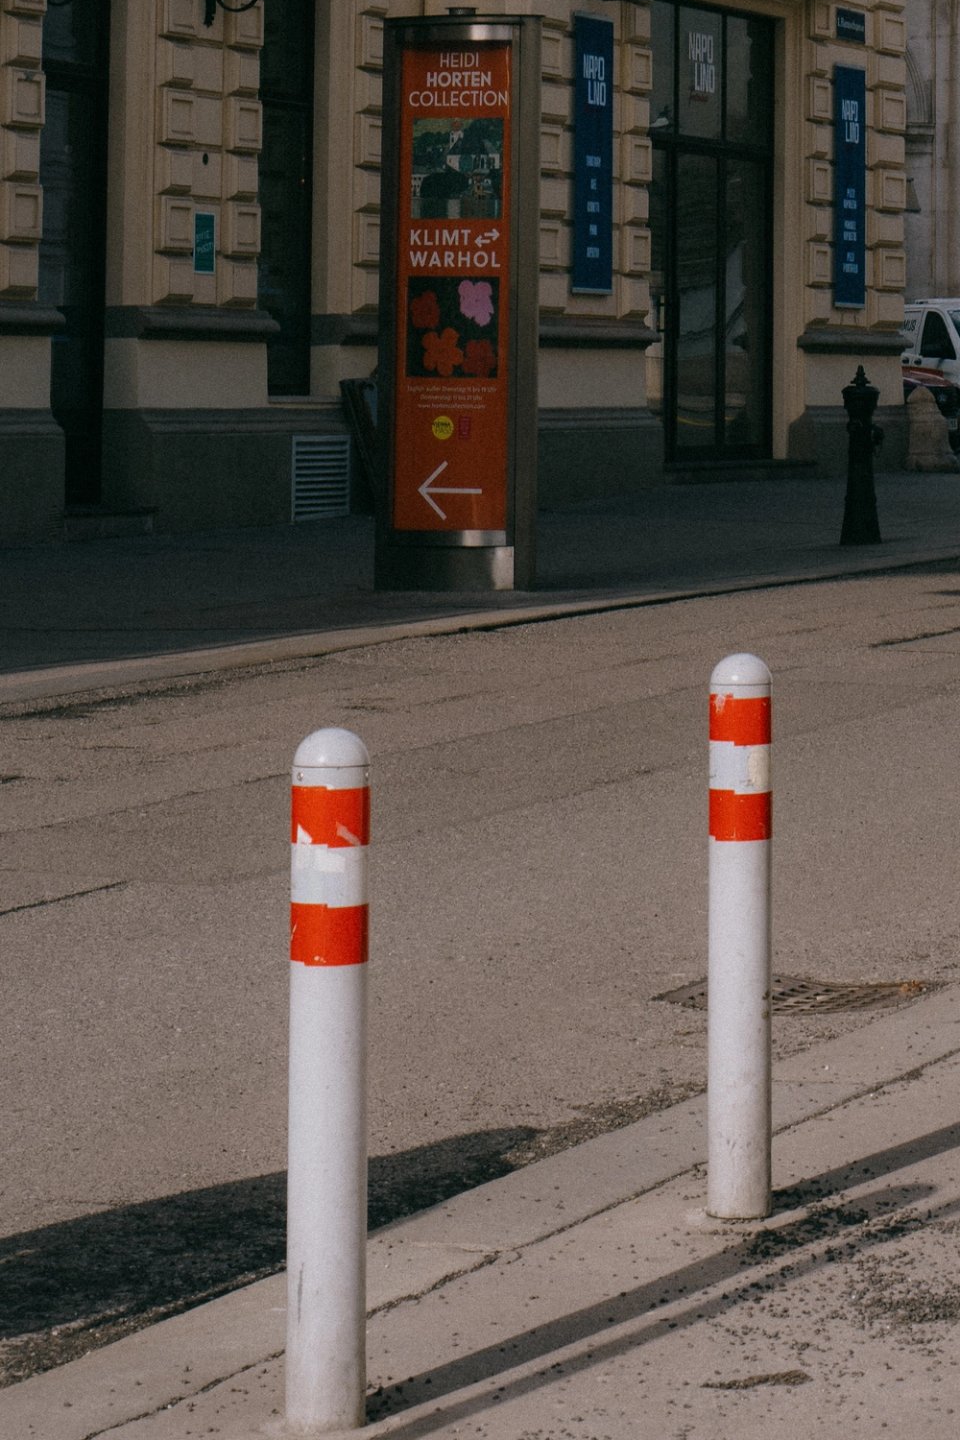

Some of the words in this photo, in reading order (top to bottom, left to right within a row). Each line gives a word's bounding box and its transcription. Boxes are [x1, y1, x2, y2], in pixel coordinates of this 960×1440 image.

[688, 32, 714, 63] NAPO
[440, 52, 479, 68] HEIDI
[583, 53, 605, 81] NAPO
[426, 71, 491, 87] HORTEN
[694, 63, 715, 93] LINO
[409, 90, 508, 108] COLLECTION
[842, 99, 859, 122] NAPO
[410, 229, 471, 246] KLIMT
[409, 251, 501, 268] WARHOL
